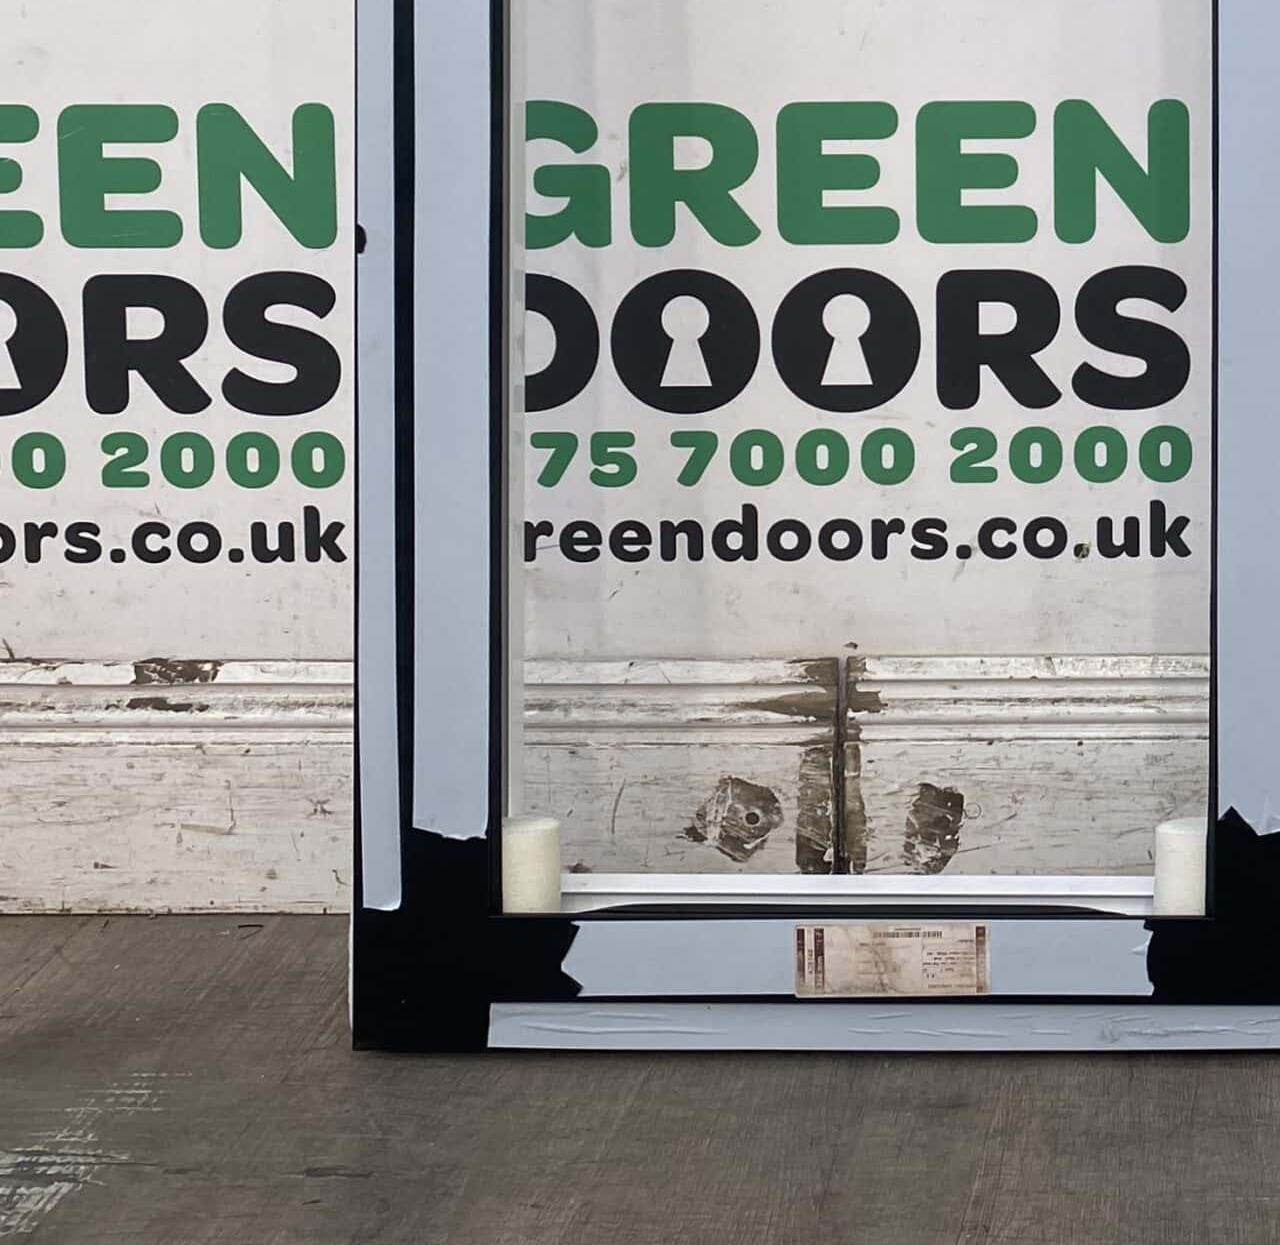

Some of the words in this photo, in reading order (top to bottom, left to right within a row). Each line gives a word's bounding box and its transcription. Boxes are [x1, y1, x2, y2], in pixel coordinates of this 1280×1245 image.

[100, 431, 346, 490] 2000
[670, 427, 916, 488] 7000
[949, 425, 1193, 485] 2000
